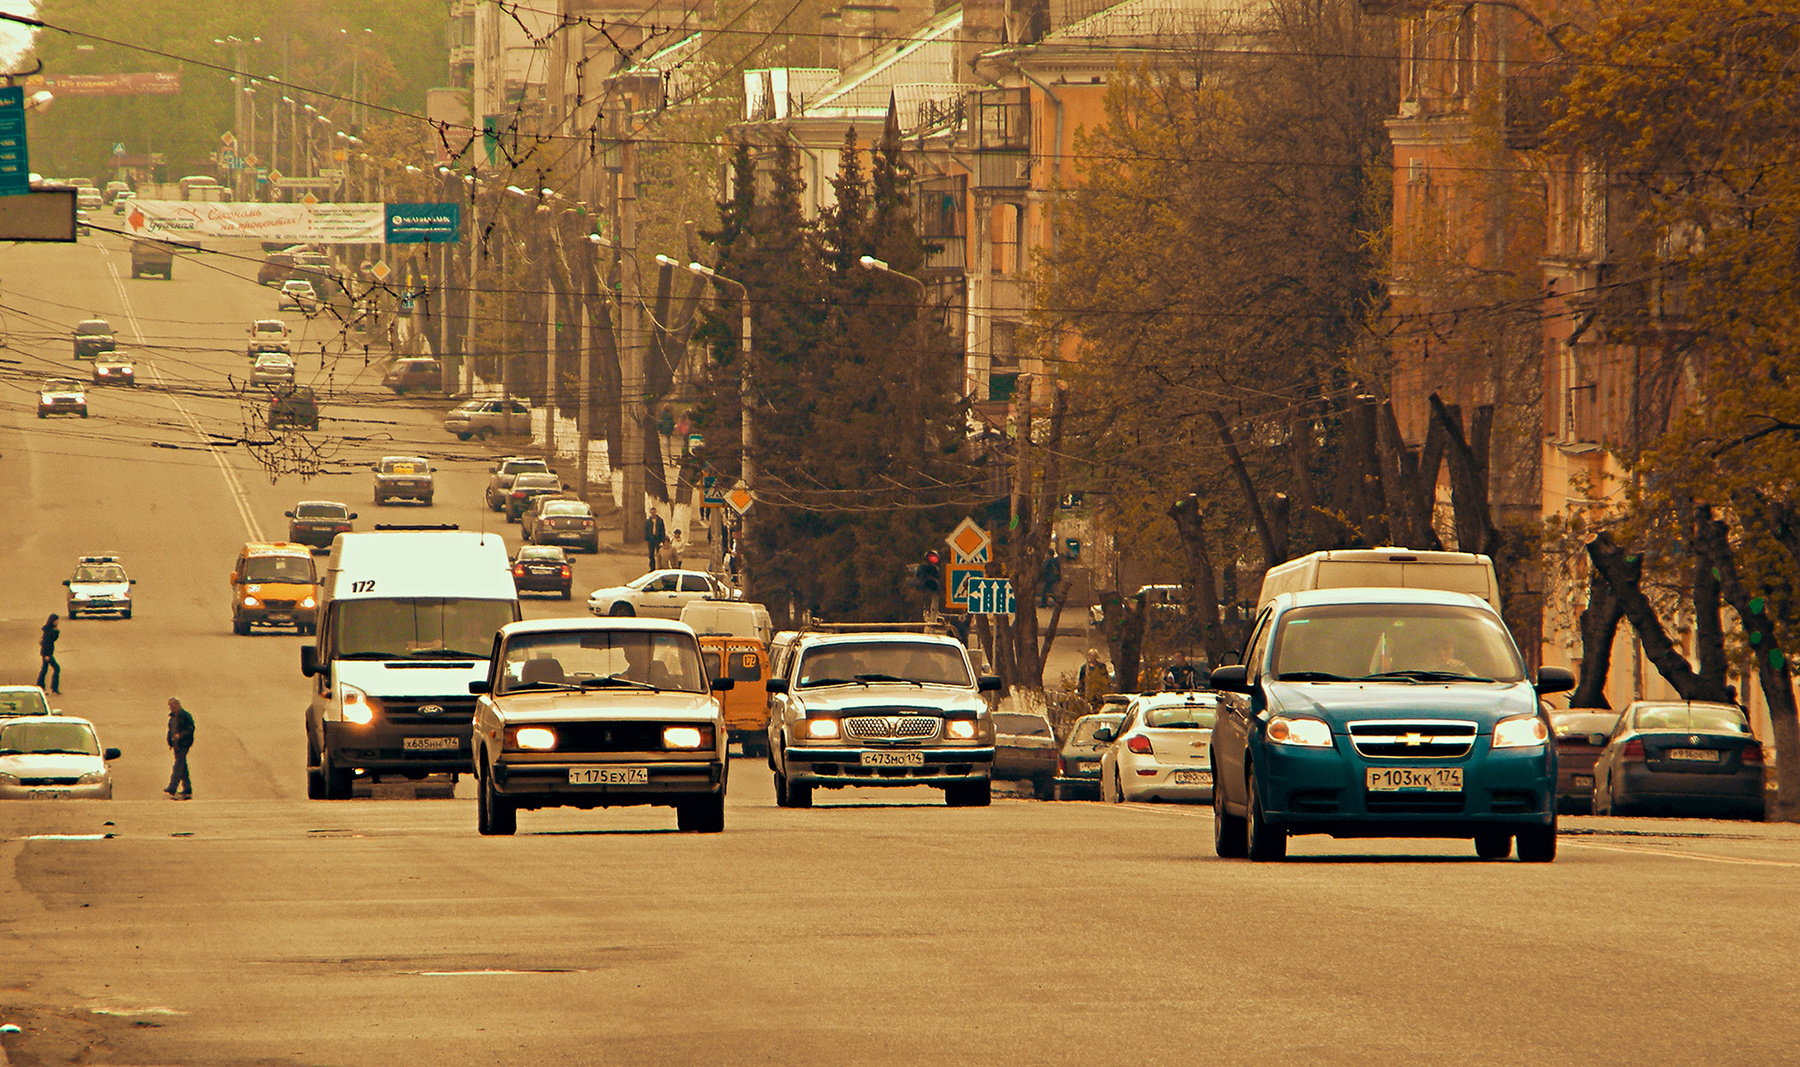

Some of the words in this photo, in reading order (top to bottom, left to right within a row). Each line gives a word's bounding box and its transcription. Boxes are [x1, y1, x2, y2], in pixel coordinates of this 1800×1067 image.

[351, 580, 376, 593] 172
[630, 769, 643, 779] 74
[1437, 770, 1460, 781] 174
